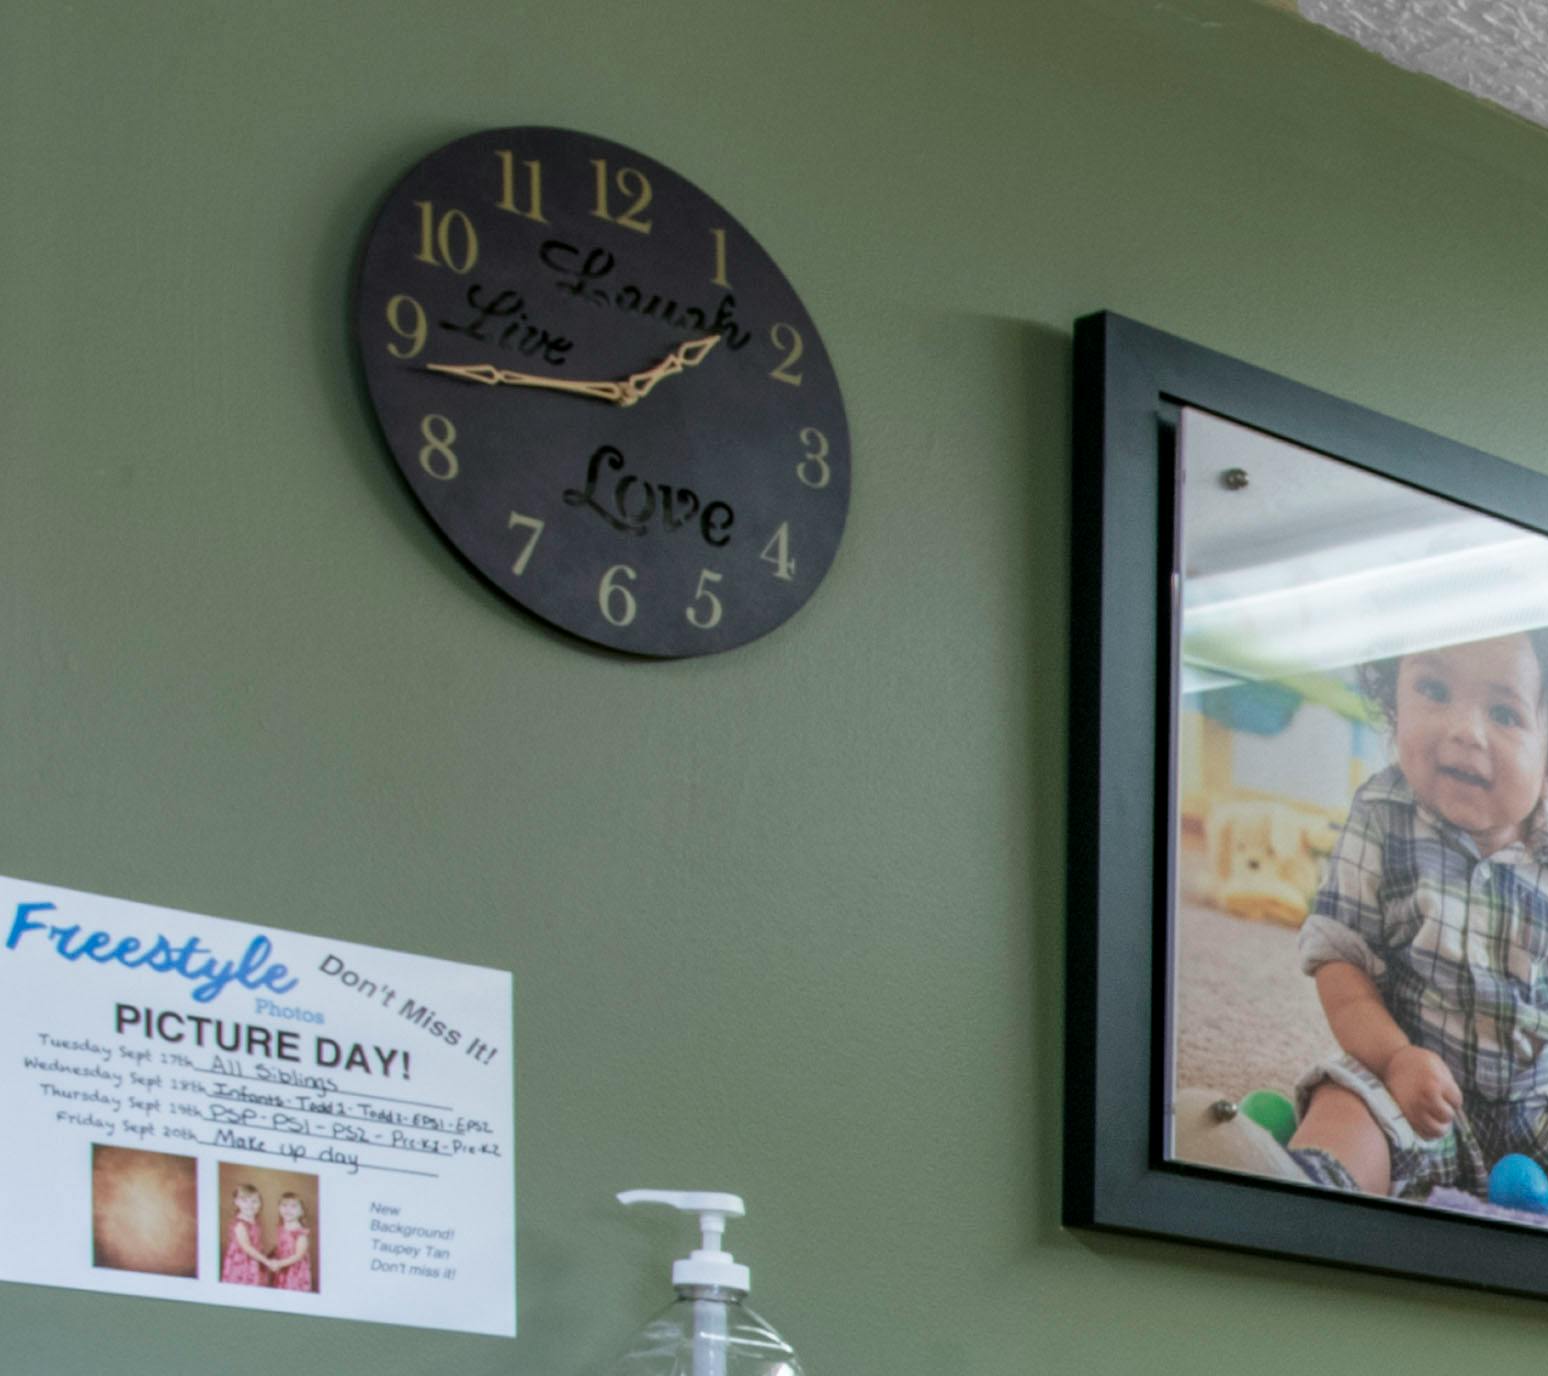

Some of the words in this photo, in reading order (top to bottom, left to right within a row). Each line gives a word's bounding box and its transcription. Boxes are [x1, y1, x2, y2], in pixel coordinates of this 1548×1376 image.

[494, 149, 549, 224] 11
[590, 159, 653, 234] 12
[415, 202, 478, 275] 10
[710, 228, 733, 290] 1
[386, 295, 428, 359] 9
[439, 284, 574, 366] Live
[770, 323, 804, 386] 2
[418, 414, 459, 481] 8
[797, 428, 831, 489] 3
[507, 510, 545, 576] 7
[761, 521, 796, 581] 4
[599, 565, 638, 627] 6
[685, 569, 724, 629] 5
[5, 902, 299, 1003] Freestyle
[115, 1003, 300, 1063] PICTURE
[316, 1036, 411, 1080] DAY!
[256, 998, 325, 1024] Photos
[319, 954, 397, 1007] Don't
[399, 999, 463, 1046] Miss
[466, 1038, 498, 1065] It!
[24, 1057, 123, 1087] Wednesday
[129, 1072, 162, 1094] Sept
[38, 1033, 112, 1061] Tuesday
[120, 1045, 152, 1067] Sept
[211, 1055, 243, 1078] All
[256, 1063, 338, 1097] Siblings
[40, 1083, 122, 1112] Thursday
[129, 1096, 161, 1117] Sept
[56, 1111, 116, 1136] Friday
[122, 1119, 155, 1140] Sept
[163, 1126, 199, 1142] 20th
[214, 1129, 266, 1153] Make
[279, 1145, 306, 1162] up
[318, 1149, 359, 1175] day
[370, 1202, 401, 1216] New
